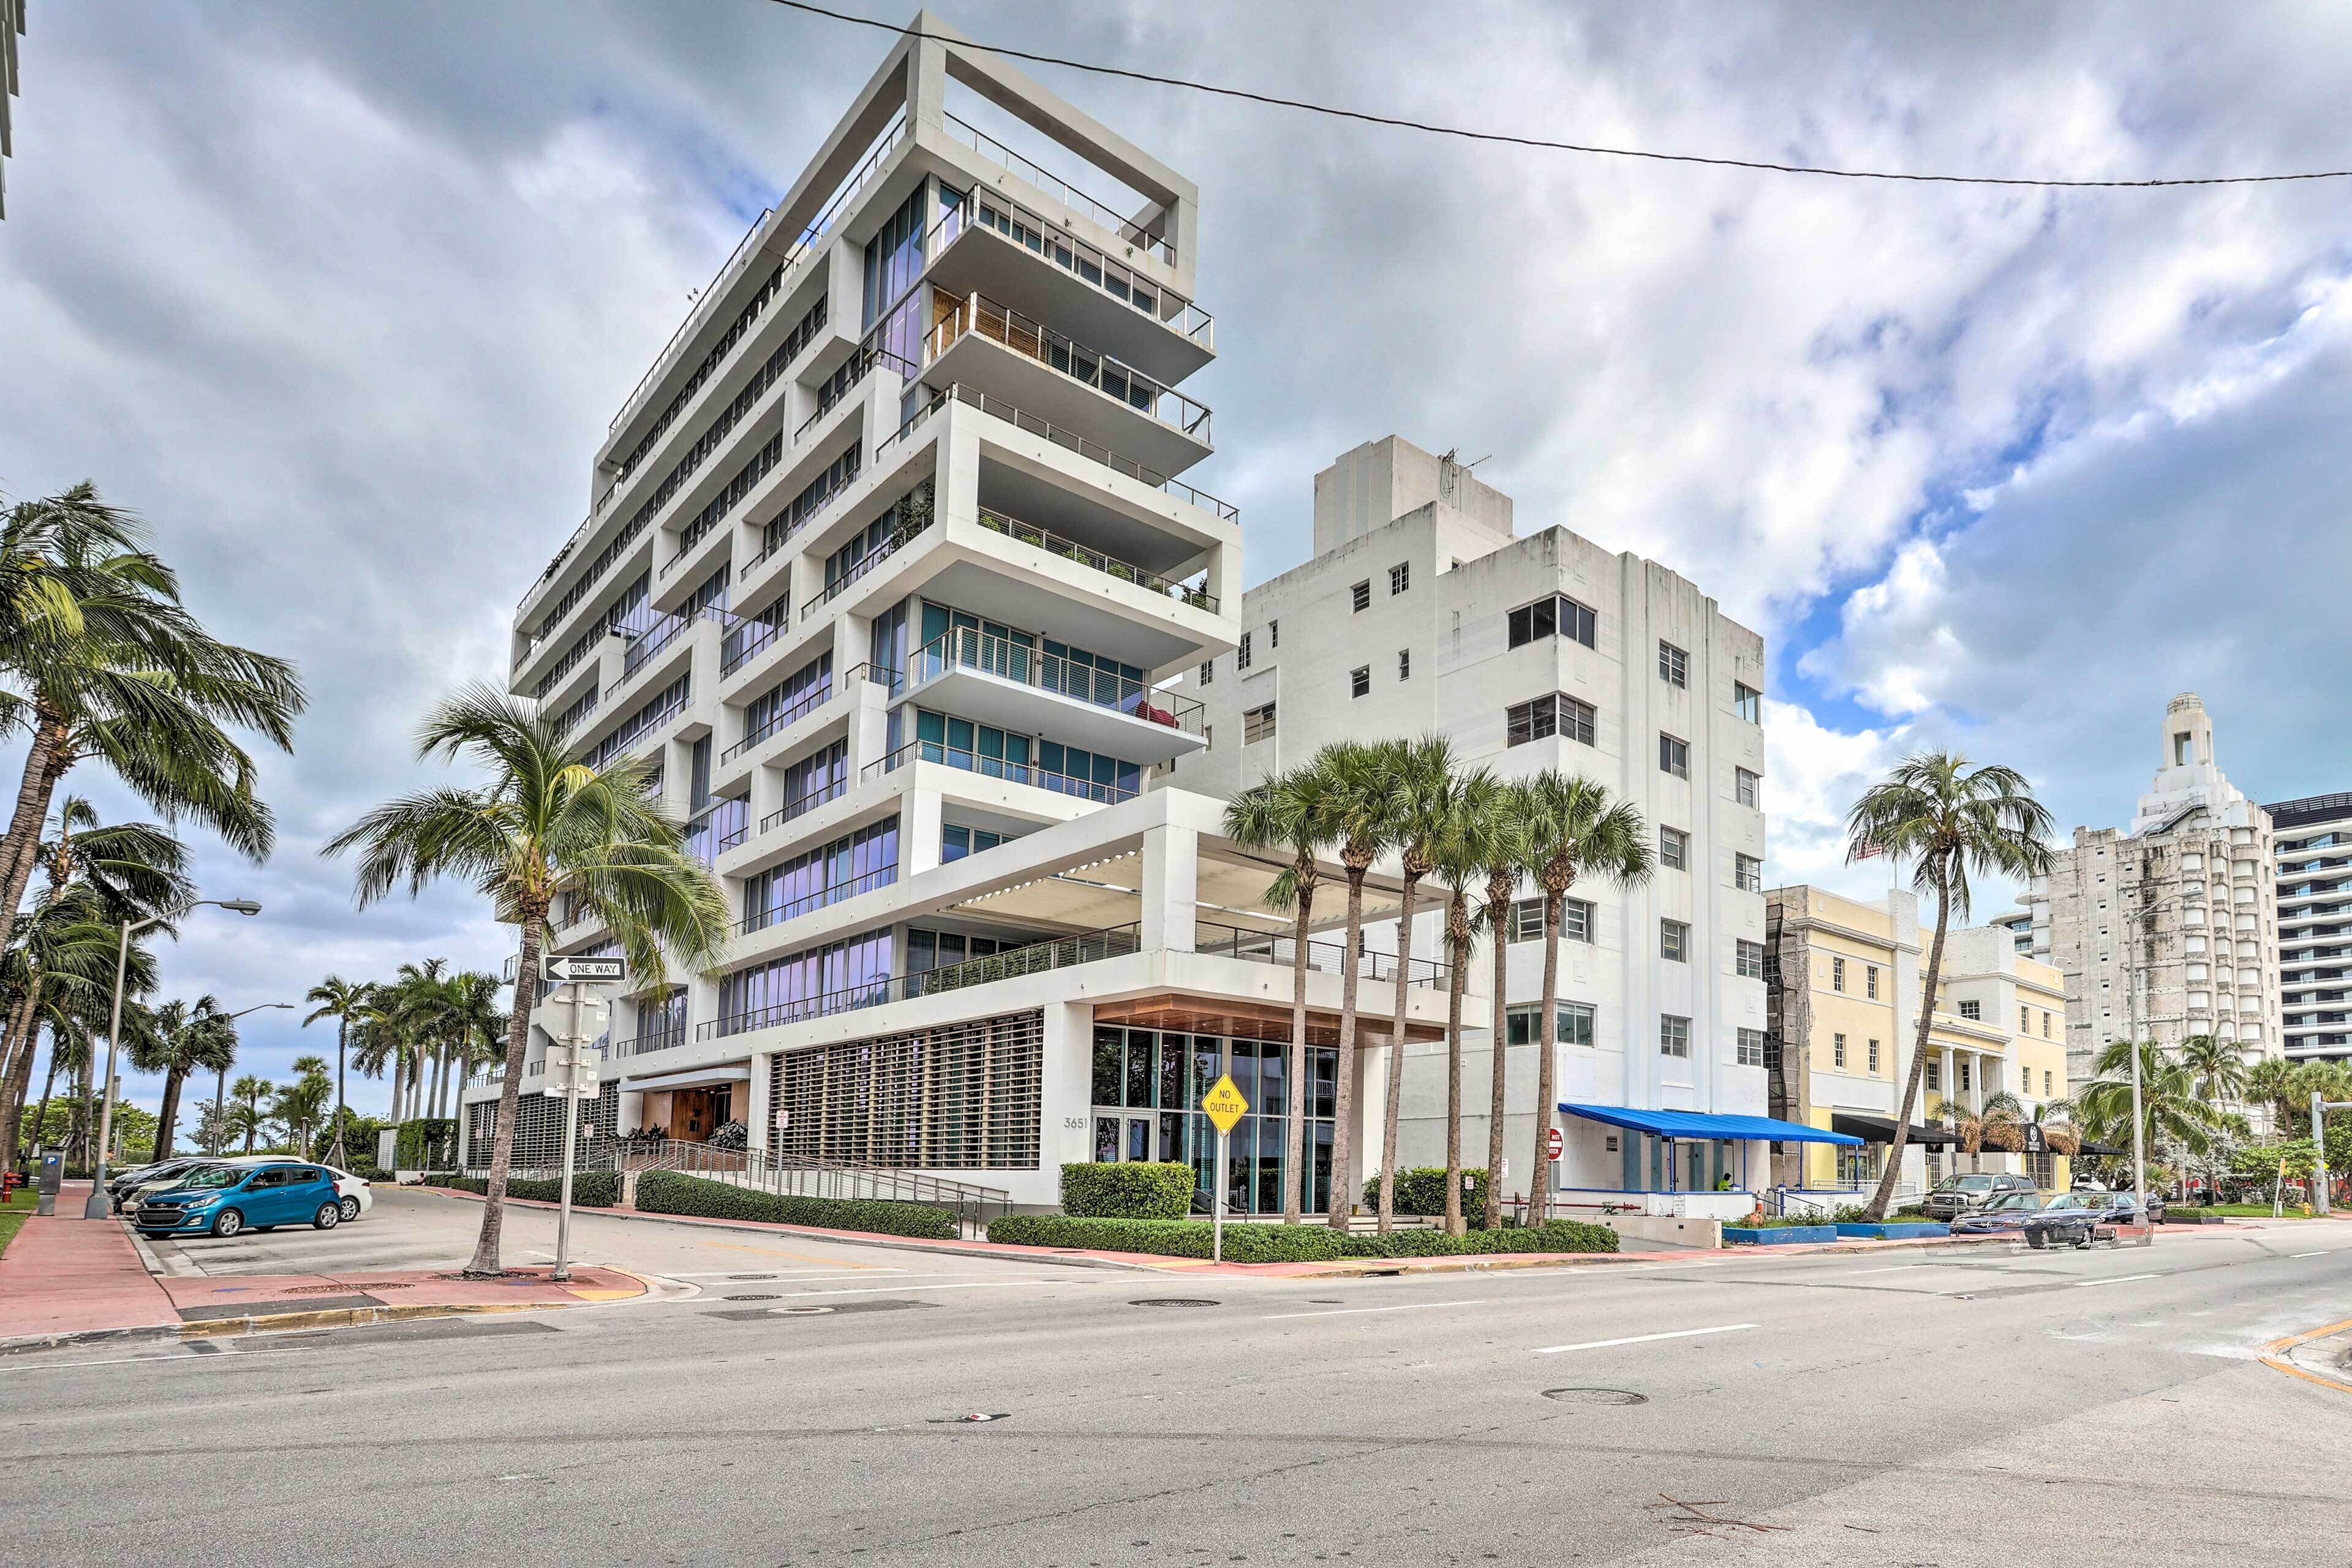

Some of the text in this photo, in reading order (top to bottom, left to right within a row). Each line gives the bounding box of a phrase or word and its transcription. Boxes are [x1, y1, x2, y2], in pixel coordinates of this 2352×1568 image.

[570, 964, 617, 974] ONE WAY
[1219, 1090, 1231, 1099] NO
[1210, 1102, 1240, 1113] OUTLET
[1064, 1117, 1087, 1129] 3651
